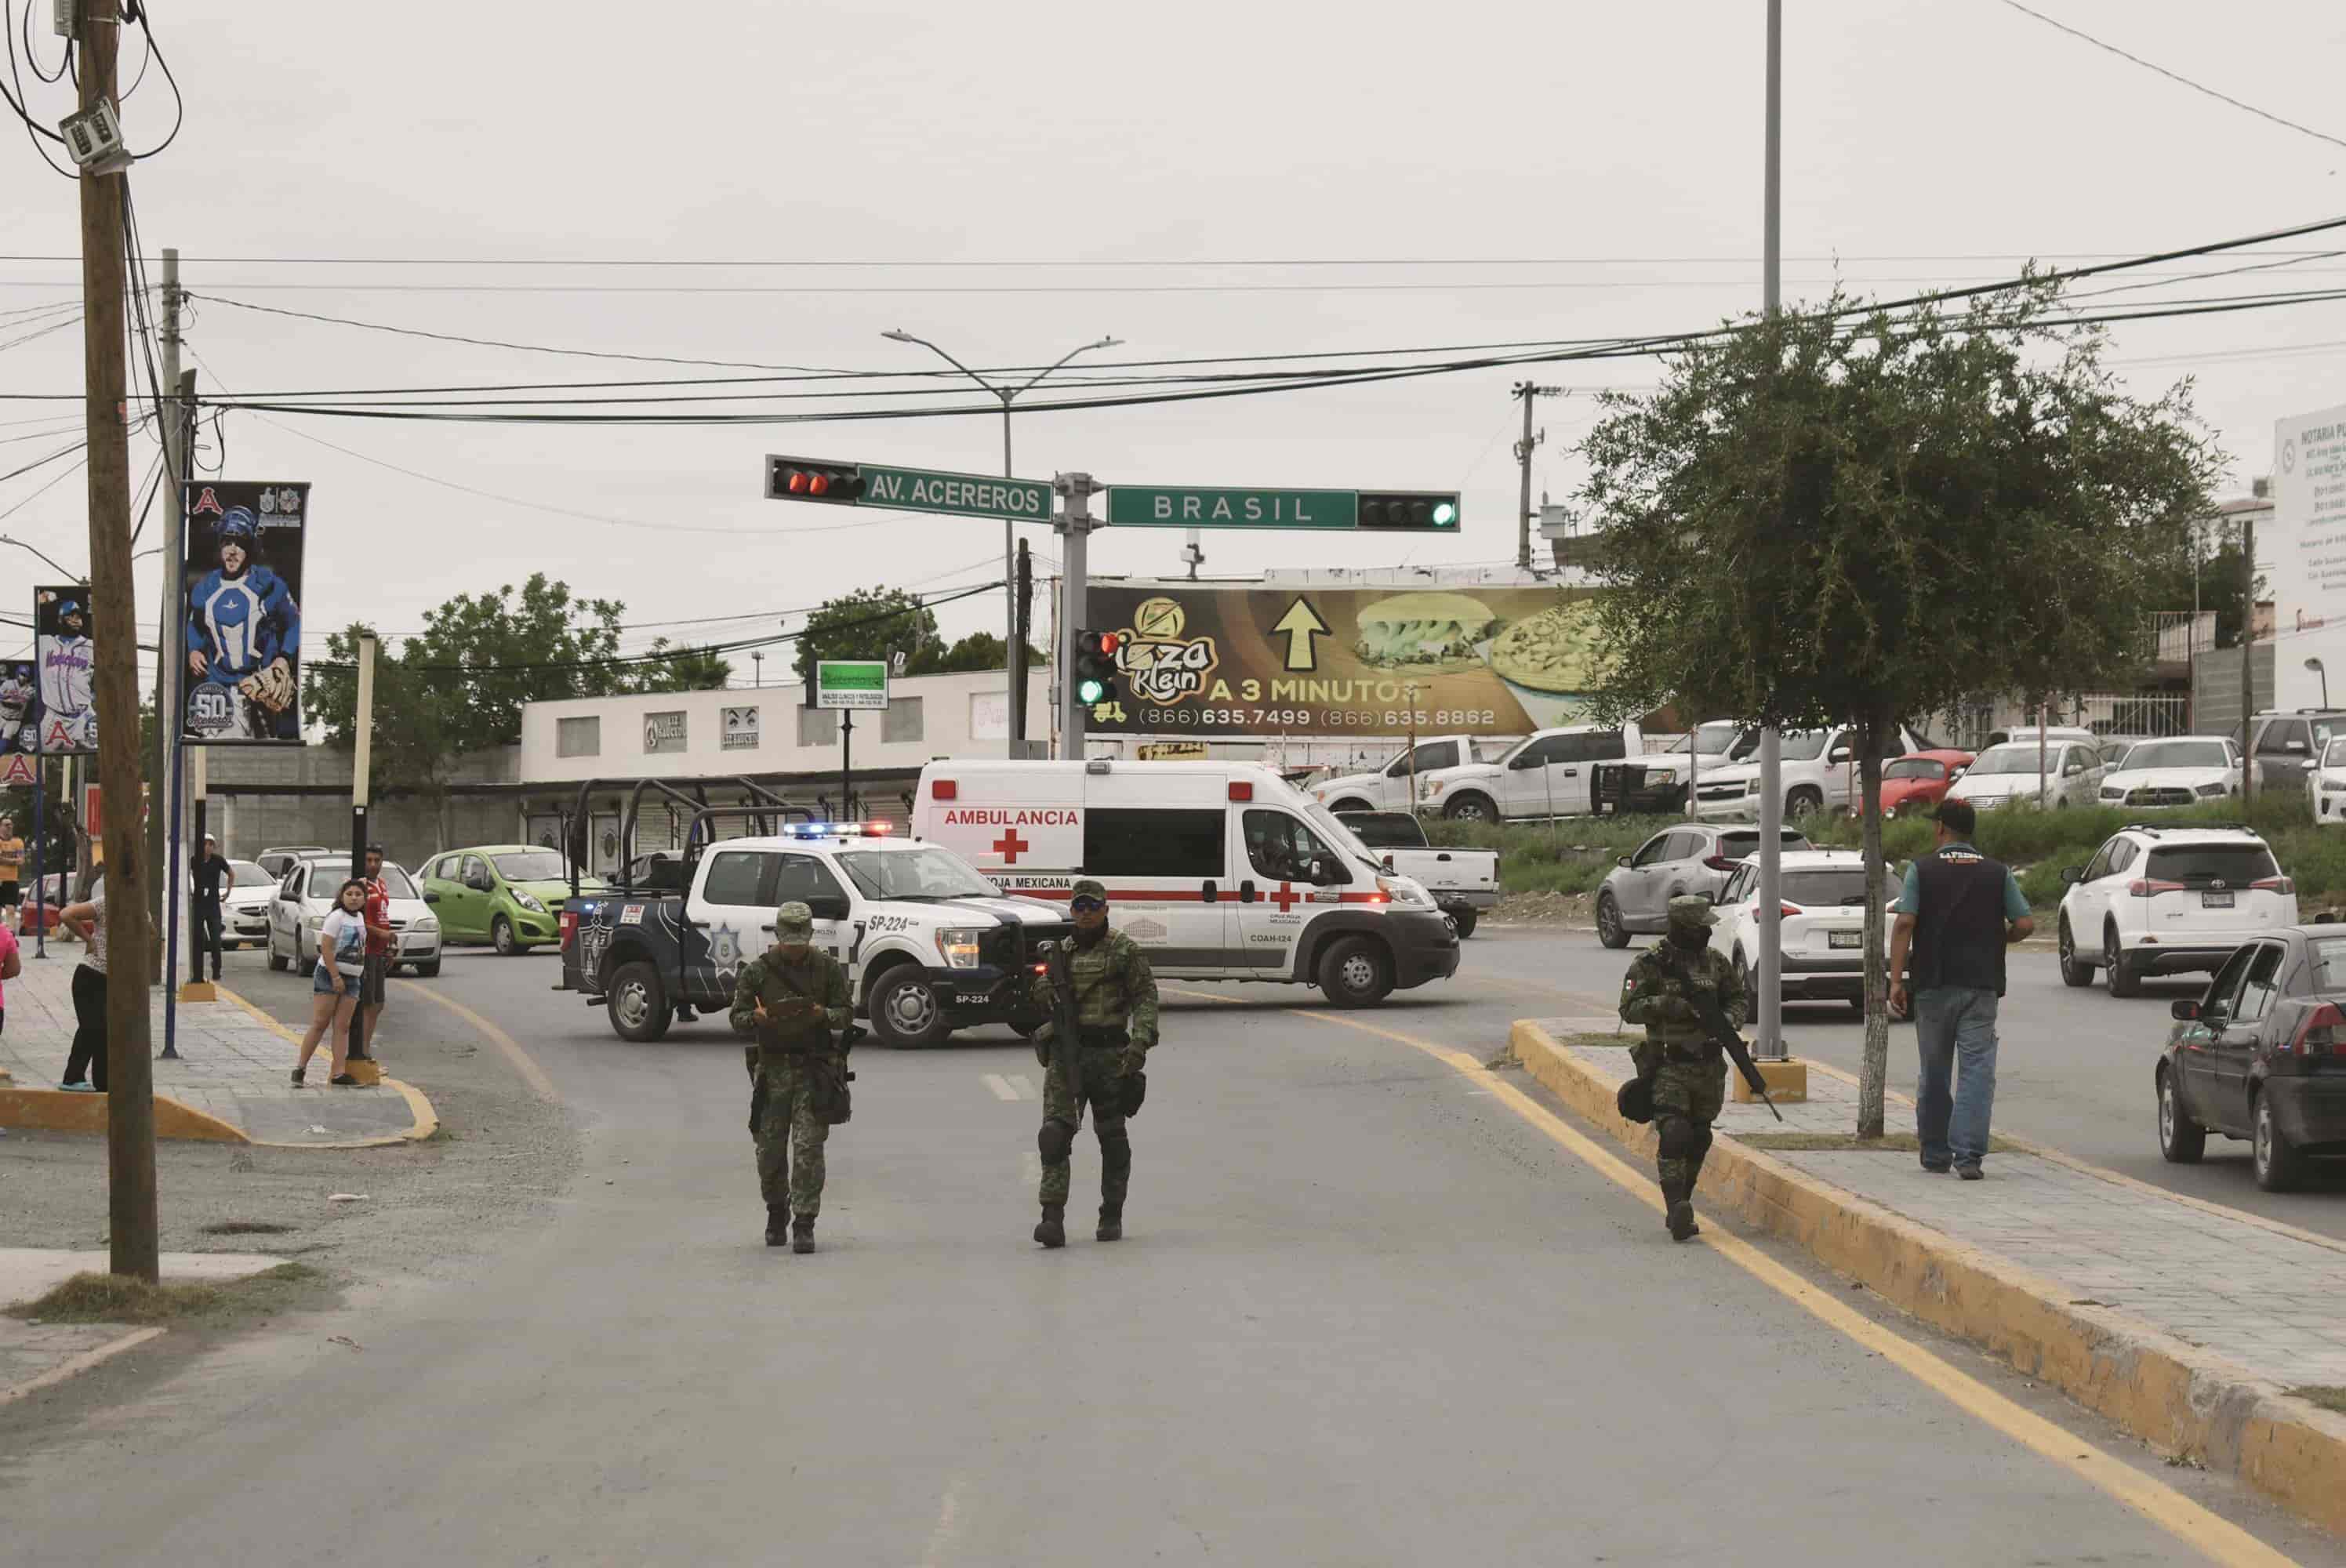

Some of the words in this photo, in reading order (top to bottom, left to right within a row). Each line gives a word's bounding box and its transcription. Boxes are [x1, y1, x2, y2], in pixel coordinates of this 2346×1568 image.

[2302, 426, 2334, 445] NOTARIA
[870, 475, 906, 499] AV.
[911, 478, 1040, 514] ACEREROS
[1154, 495, 1312, 521] BRASIL
[1133, 660, 1197, 699] Klein
[1209, 679, 1233, 702] A
[1241, 679, 1262, 702] 3
[1271, 679, 1421, 702] MINUTOS
[196, 694, 226, 717] 50
[1138, 709, 1310, 725] (866)635.7499
[1320, 710, 1494, 727] (866)635.8862
[945, 810, 1079, 825] AMBULANCIA
[1016, 877, 1071, 888] MEXICANA
[869, 916, 909, 931] SP-224
[956, 994, 990, 1004] SP-224
